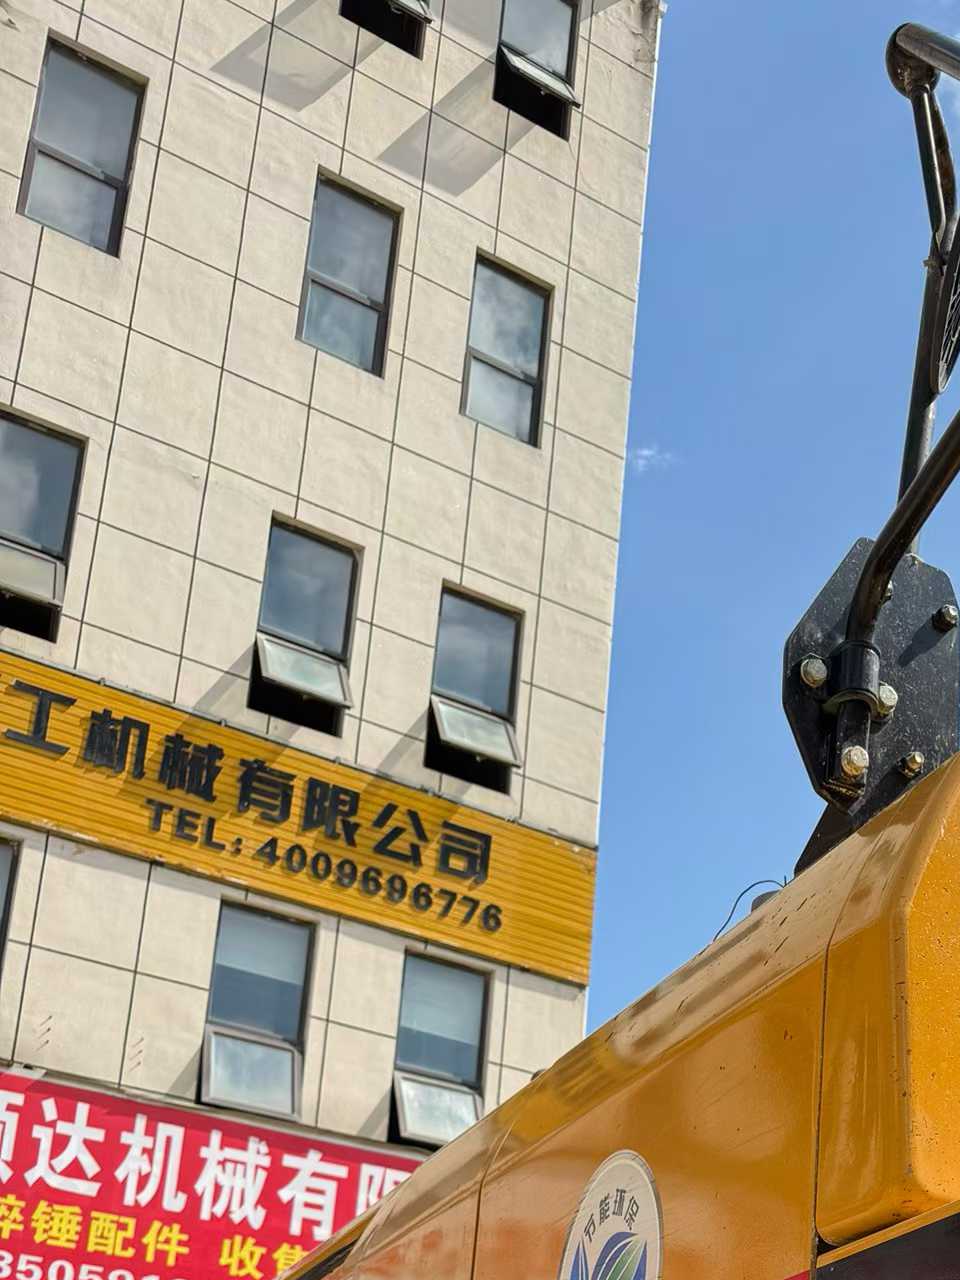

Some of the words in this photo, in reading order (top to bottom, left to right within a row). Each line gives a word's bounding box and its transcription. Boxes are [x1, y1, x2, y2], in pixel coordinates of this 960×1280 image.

[3, 679, 494, 888] 工机械有限公司
